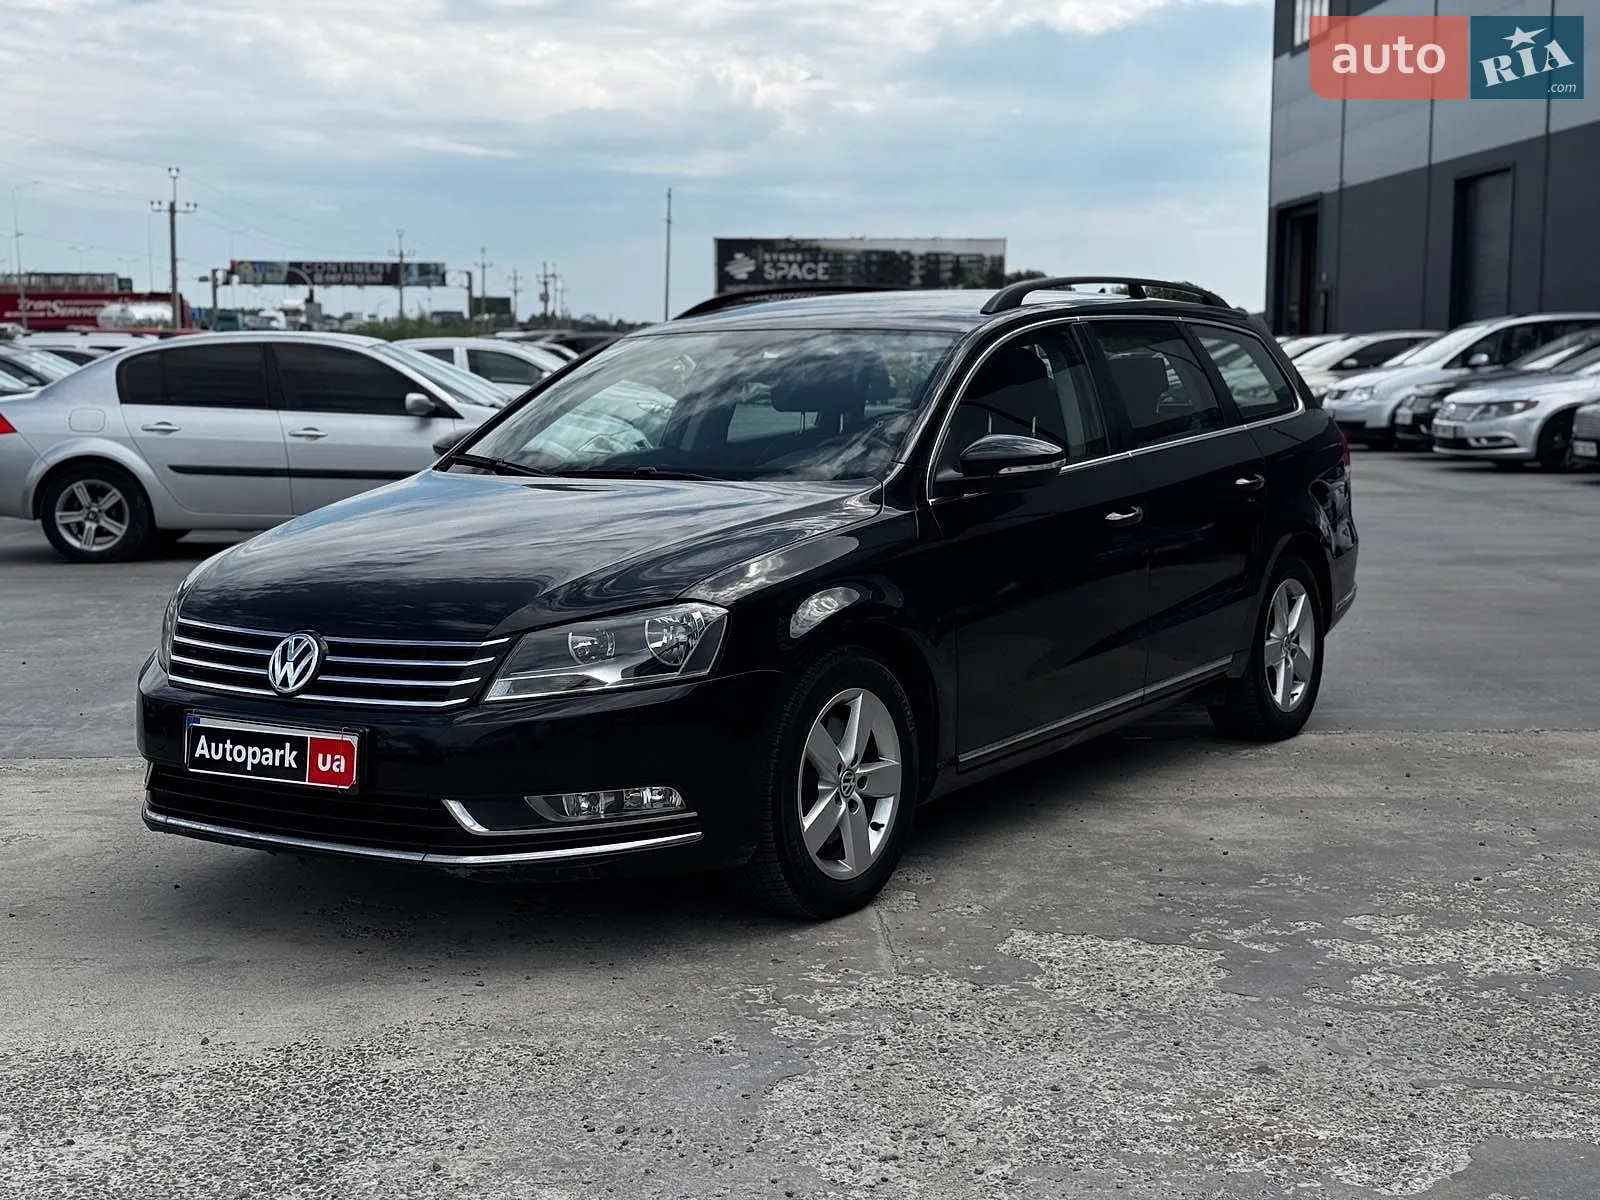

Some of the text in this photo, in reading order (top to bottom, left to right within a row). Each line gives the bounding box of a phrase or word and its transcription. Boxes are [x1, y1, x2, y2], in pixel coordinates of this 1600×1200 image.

[763, 261, 831, 281] SPACE
[194, 734, 346, 773] Autopark ua
